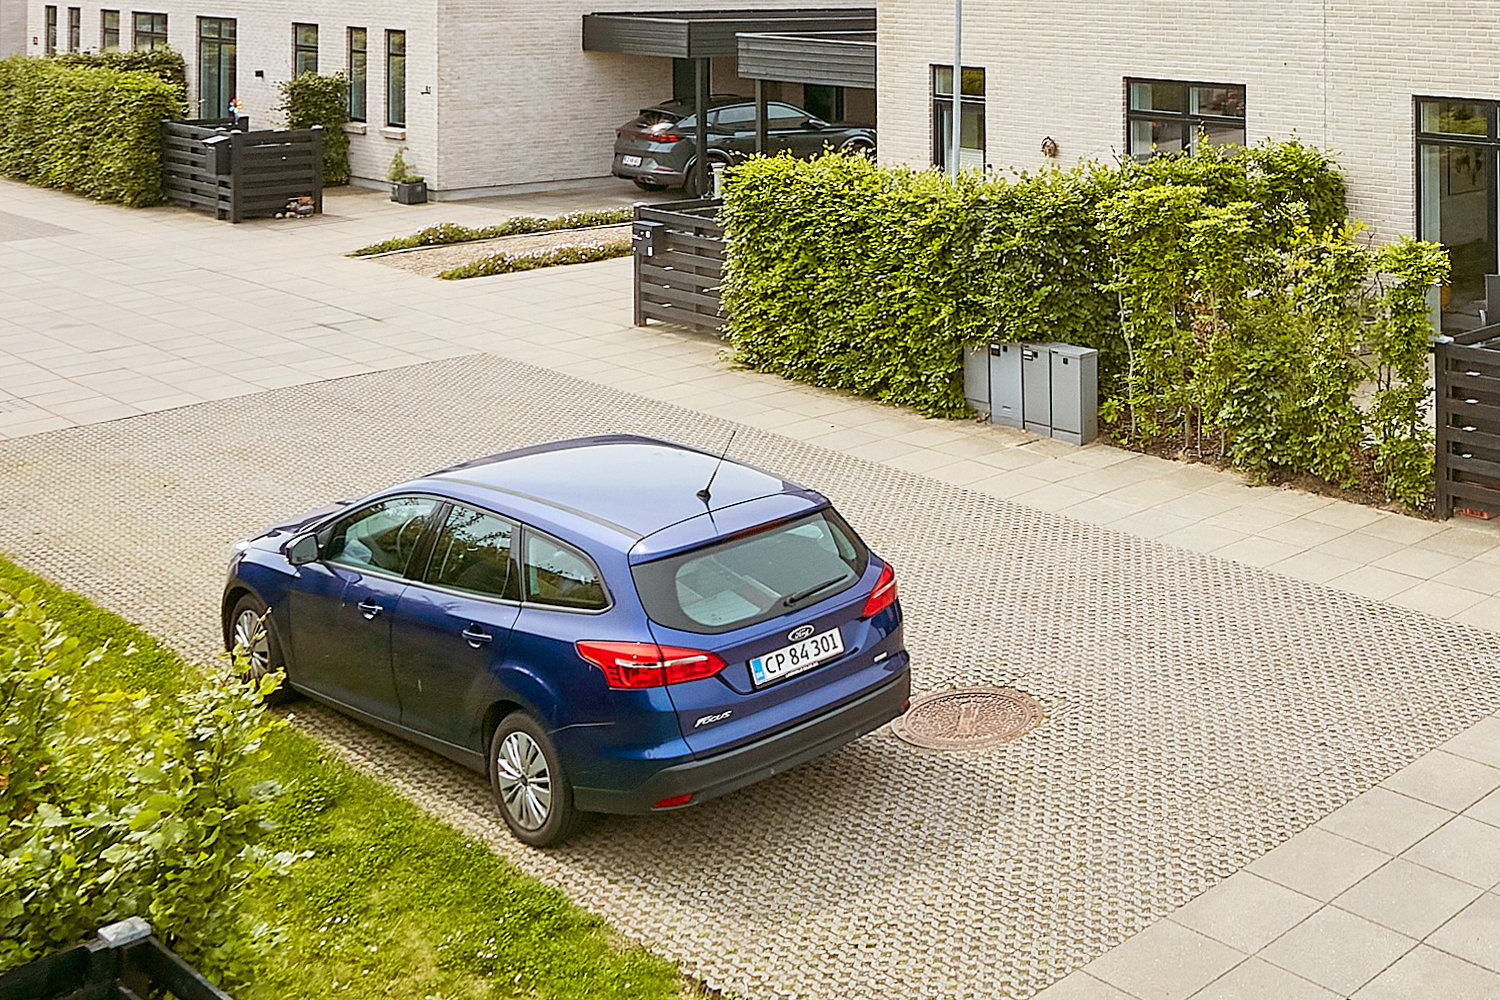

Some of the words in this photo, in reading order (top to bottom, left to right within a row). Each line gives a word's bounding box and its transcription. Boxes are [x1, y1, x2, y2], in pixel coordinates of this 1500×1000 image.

[765, 654, 785, 674] CP
[789, 644, 810, 669] 84
[811, 633, 839, 657] 301
